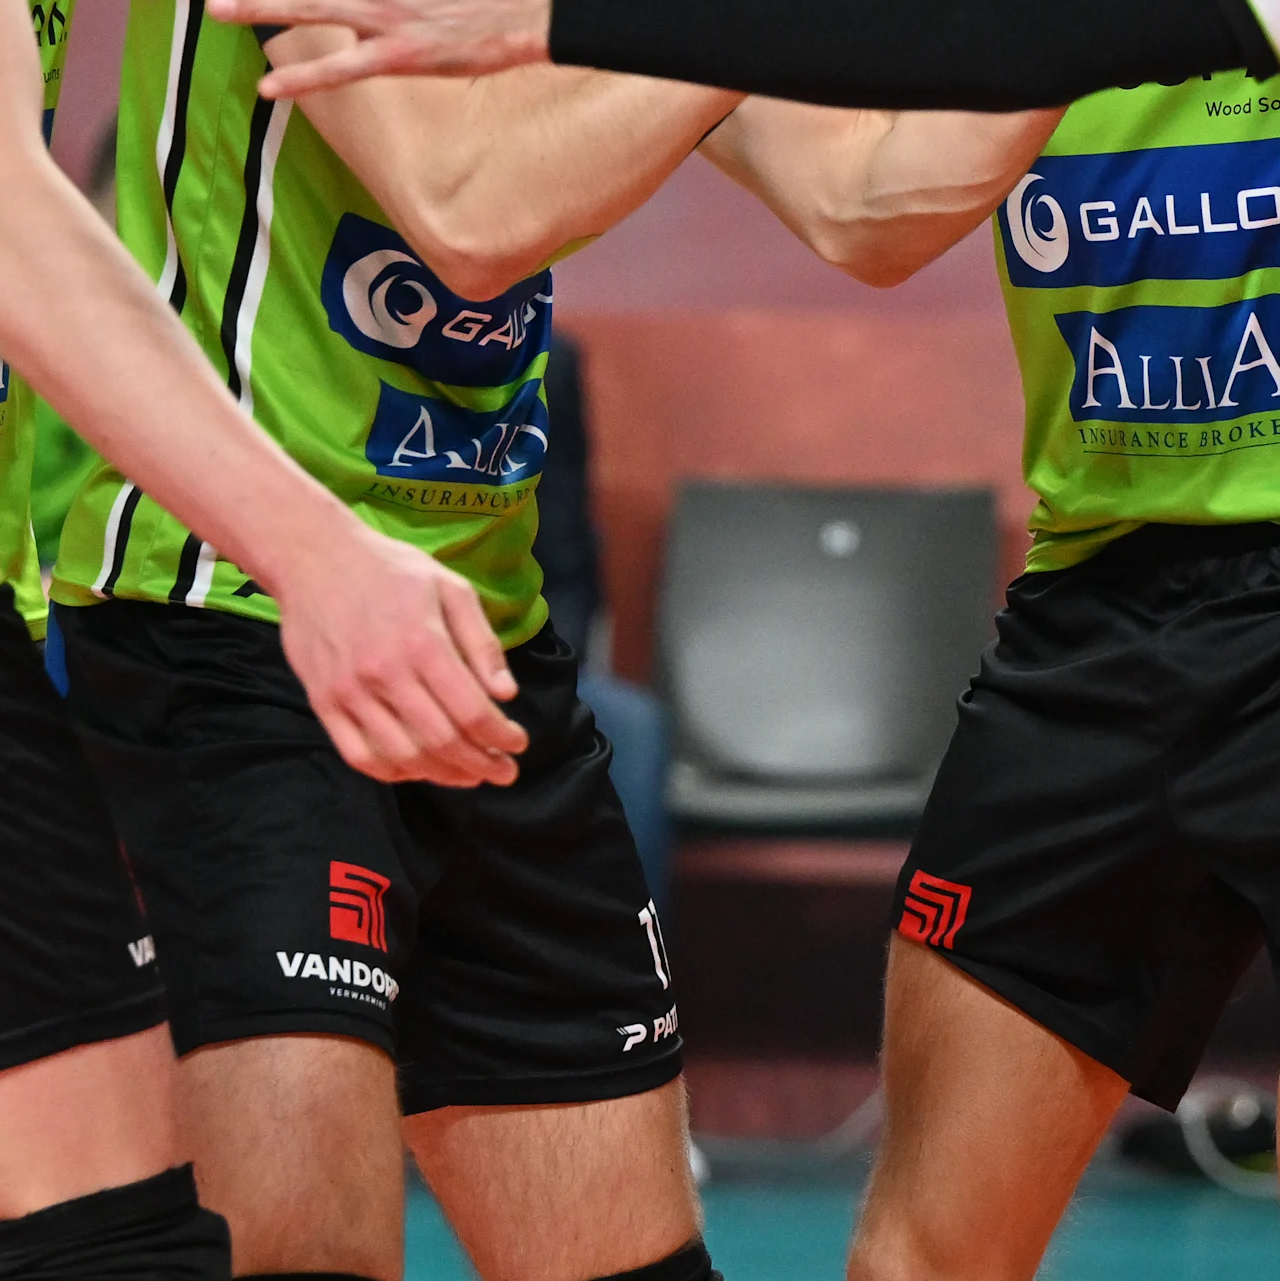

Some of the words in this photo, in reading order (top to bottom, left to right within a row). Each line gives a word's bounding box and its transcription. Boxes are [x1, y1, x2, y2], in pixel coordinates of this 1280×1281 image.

[1206, 97, 1252, 116] Wood
[1080, 427, 1189, 450] INSURANCE
[368, 481, 511, 509] INSURANCE
